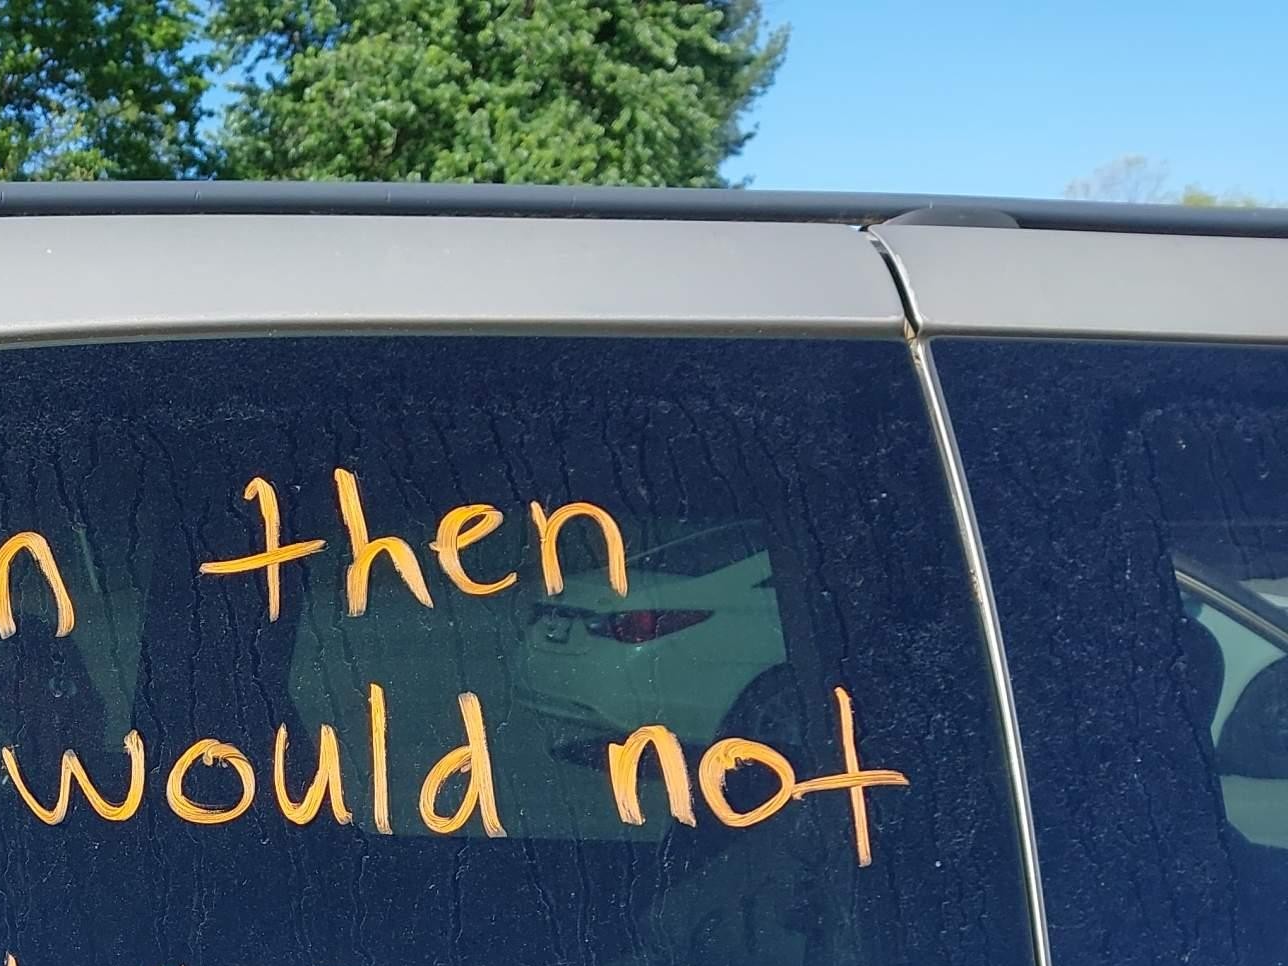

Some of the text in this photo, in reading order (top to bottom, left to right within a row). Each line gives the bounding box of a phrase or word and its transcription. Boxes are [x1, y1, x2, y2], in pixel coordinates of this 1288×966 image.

[199, 467, 629, 618] then
[1, 683, 503, 838] would
[608, 685, 909, 867] not
